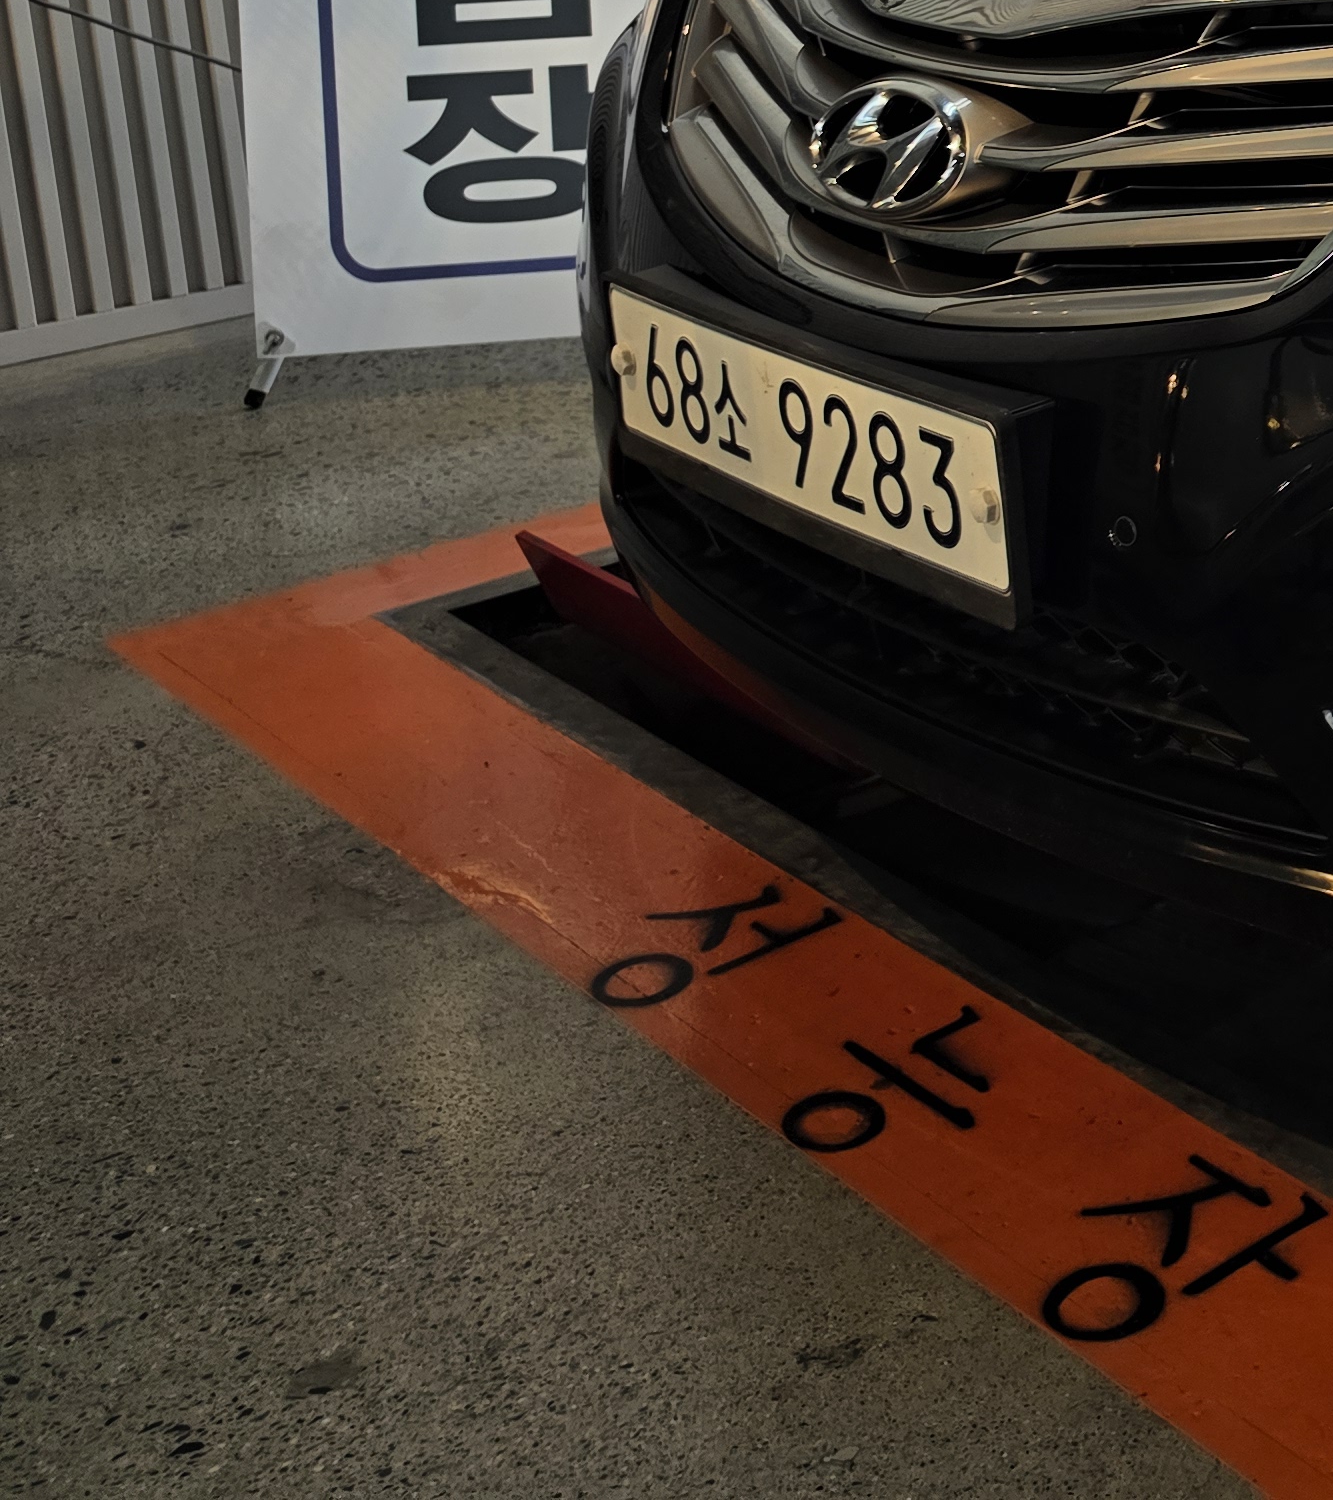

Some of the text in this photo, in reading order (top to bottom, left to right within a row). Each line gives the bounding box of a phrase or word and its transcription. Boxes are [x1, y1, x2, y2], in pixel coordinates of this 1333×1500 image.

[645, 323, 962, 549] 68소 9283
[591, 885, 1329, 1342] 성능장
